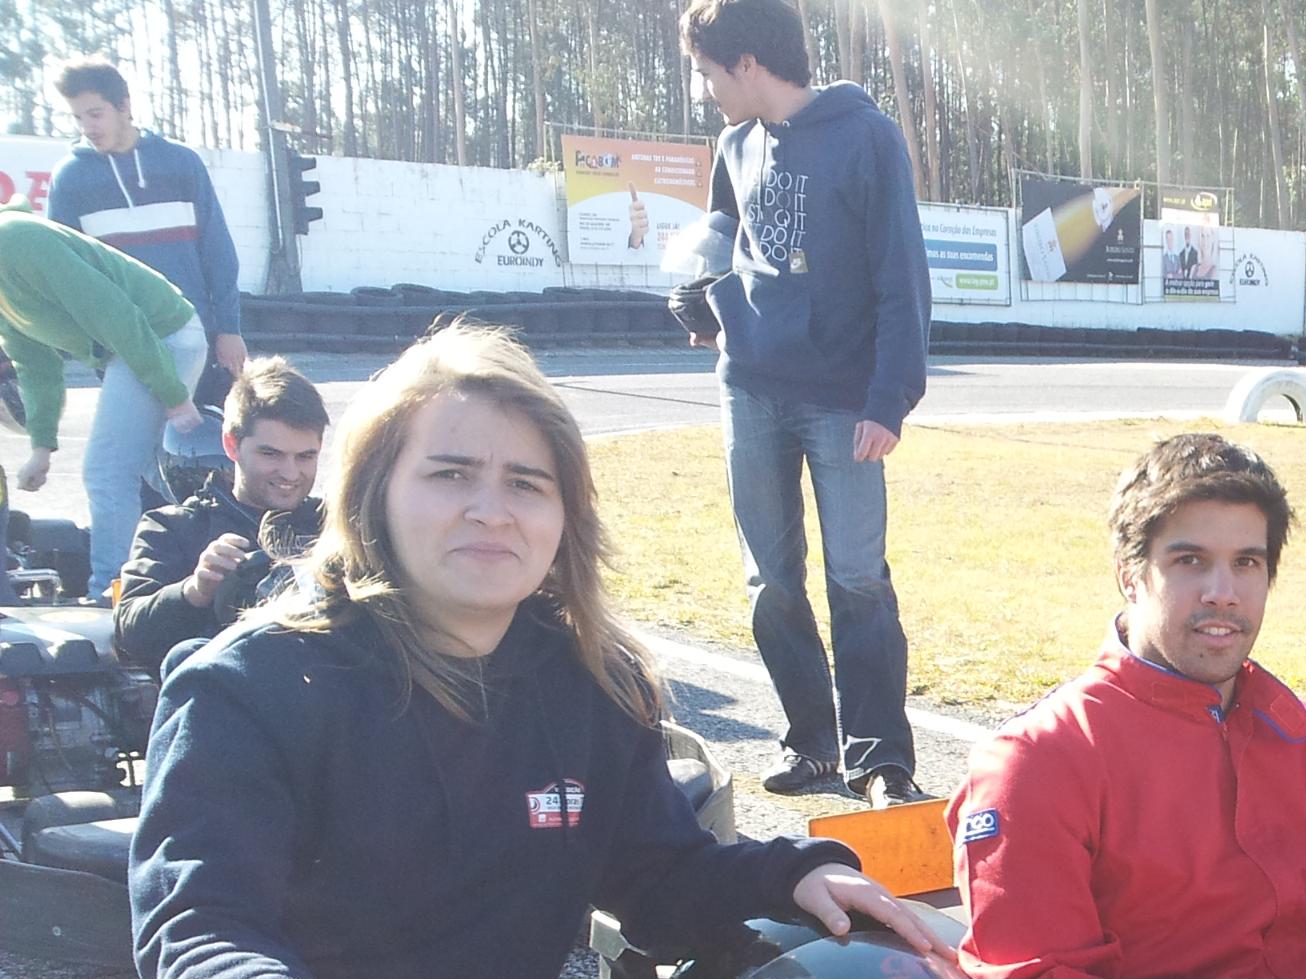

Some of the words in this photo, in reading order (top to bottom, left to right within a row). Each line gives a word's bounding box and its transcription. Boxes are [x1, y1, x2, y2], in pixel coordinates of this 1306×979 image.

[474, 219, 511, 264] ESCOLA
[518, 218, 562, 268] KARTING
[761, 225, 787, 244] DO
[497, 255, 544, 267] EUROINDY
